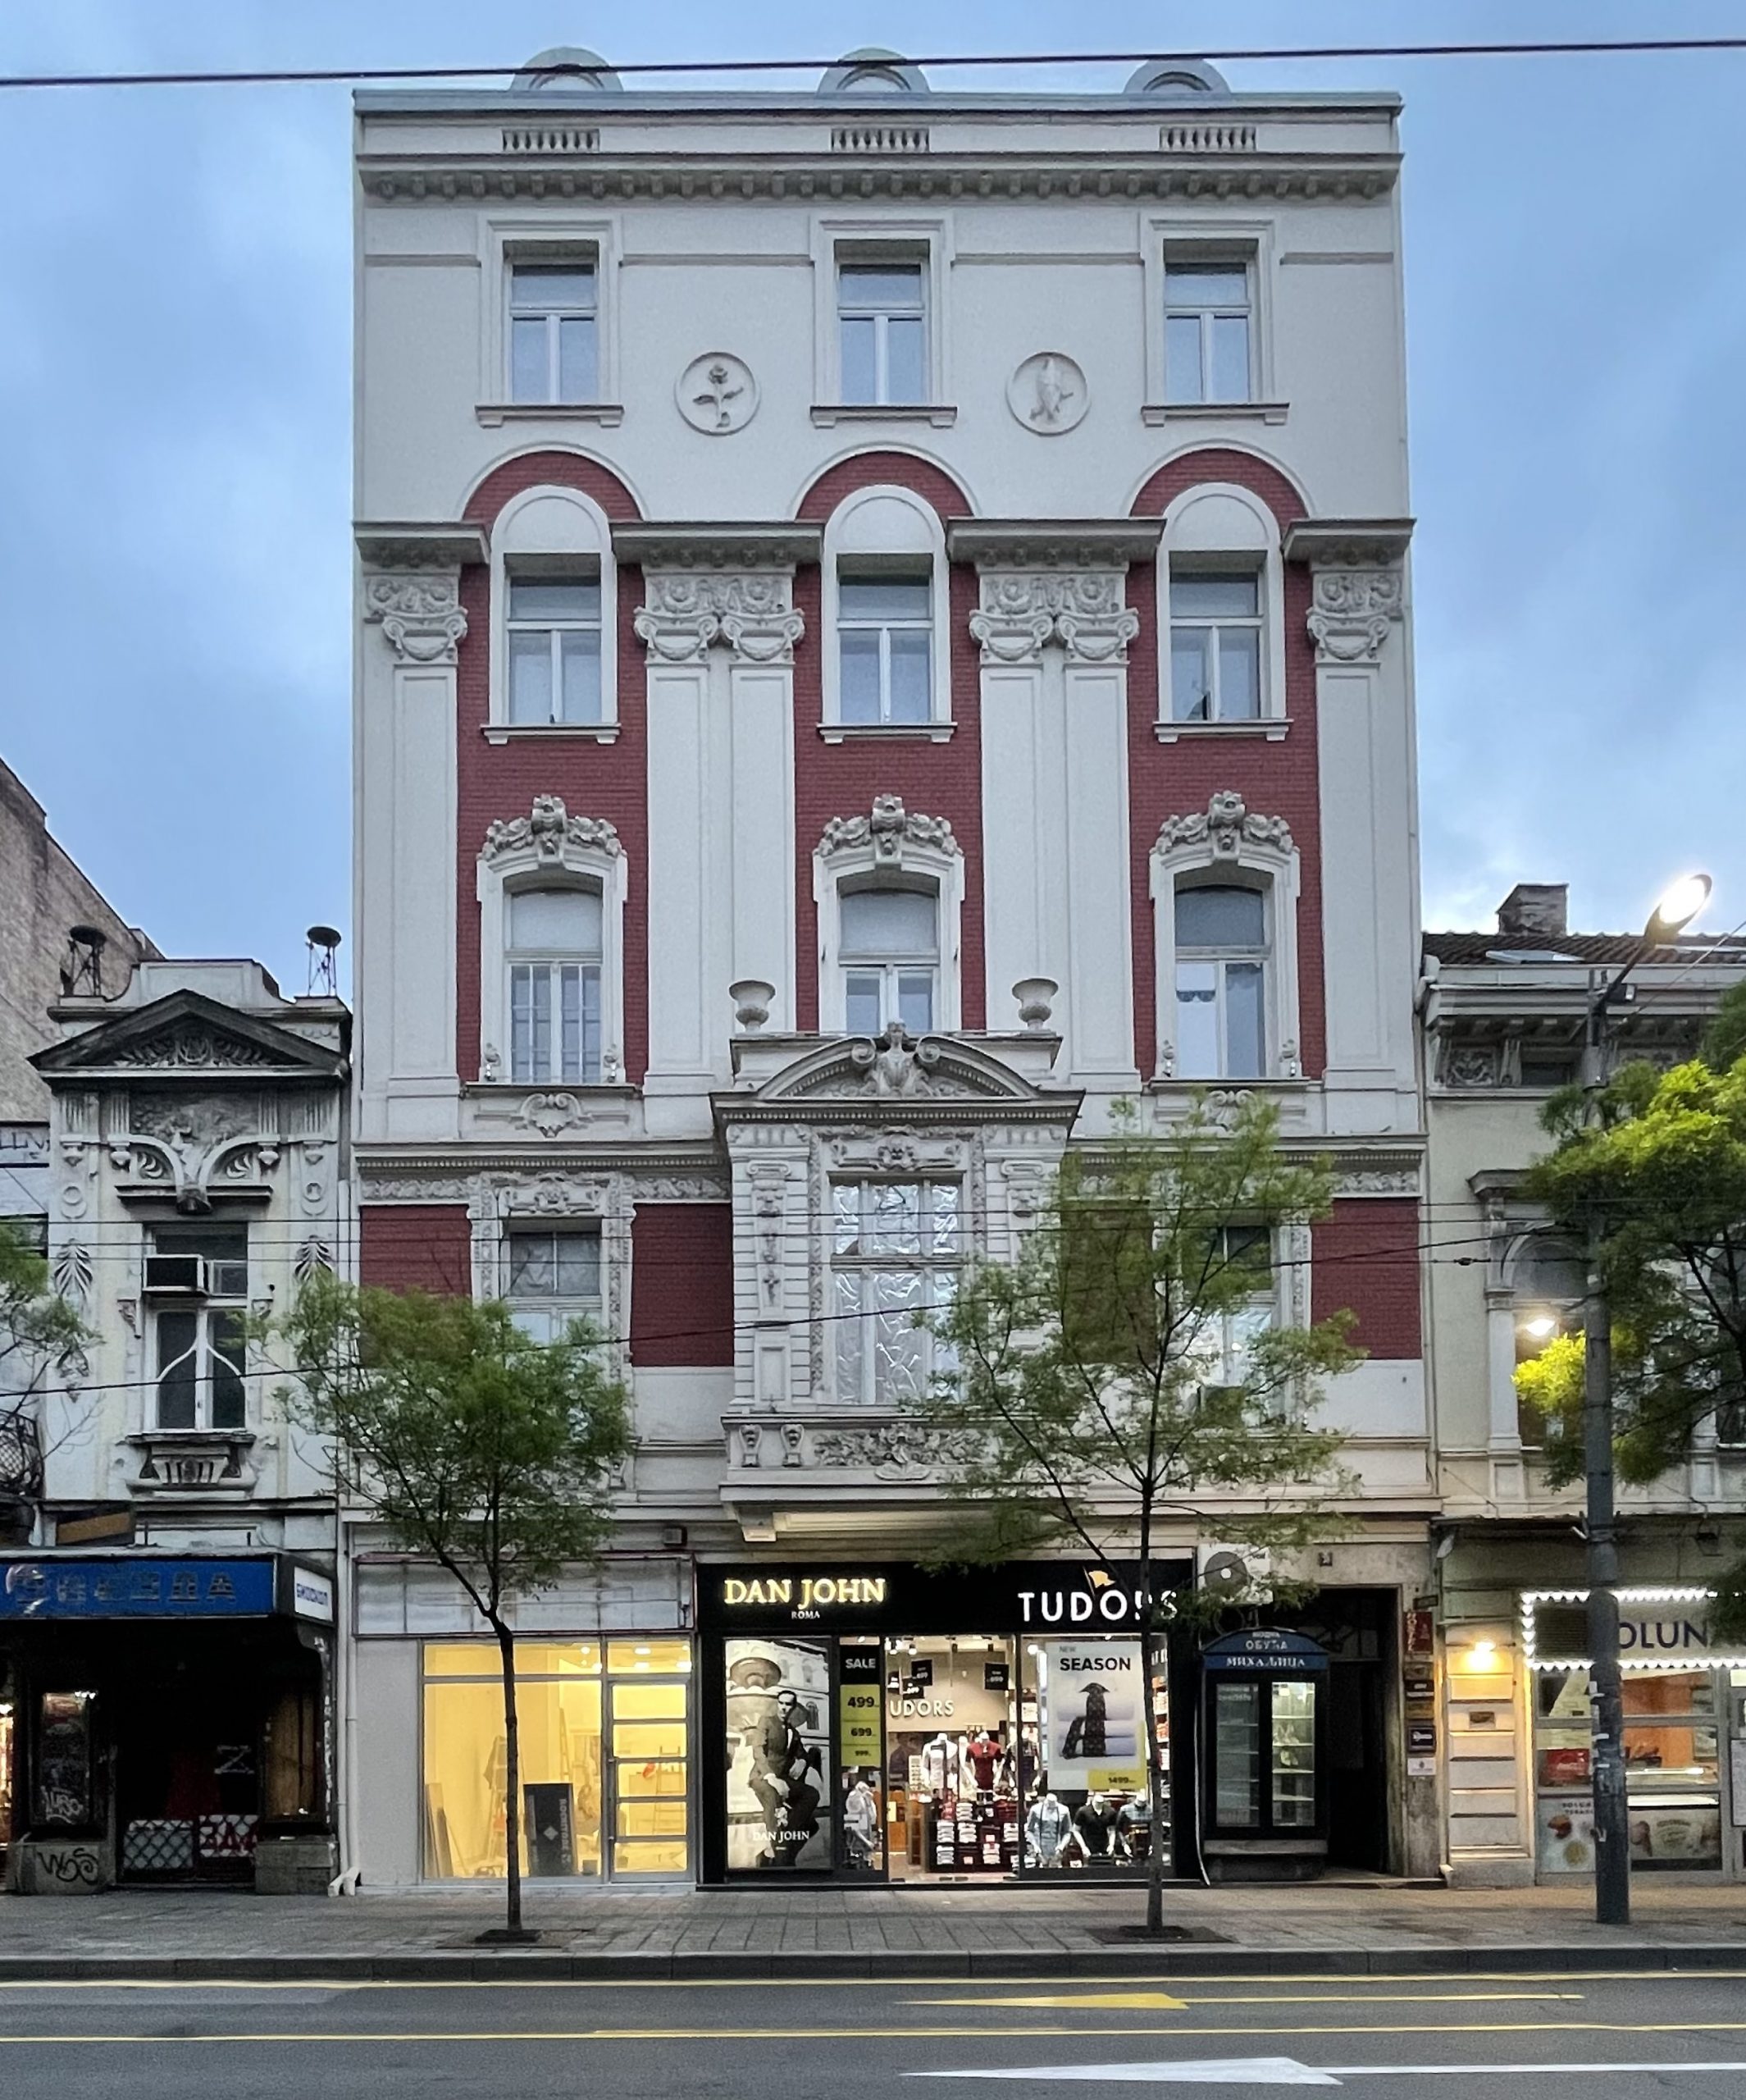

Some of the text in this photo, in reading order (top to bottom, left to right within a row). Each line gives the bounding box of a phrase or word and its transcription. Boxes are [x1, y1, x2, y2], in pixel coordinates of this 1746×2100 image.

[724, 1578, 886, 1609] DAN JOHN
[791, 1610, 820, 1619] ROMA
[1619, 1621, 1708, 1649] OLUN
[846, 1658, 876, 1669] SALE
[1060, 1657, 1131, 1671] SEASON
[848, 1696, 875, 1708] 499
[890, 1700, 955, 1717] UDORS
[850, 1728, 872, 1737] 699
[753, 1830, 809, 1843] DAN JOHN
